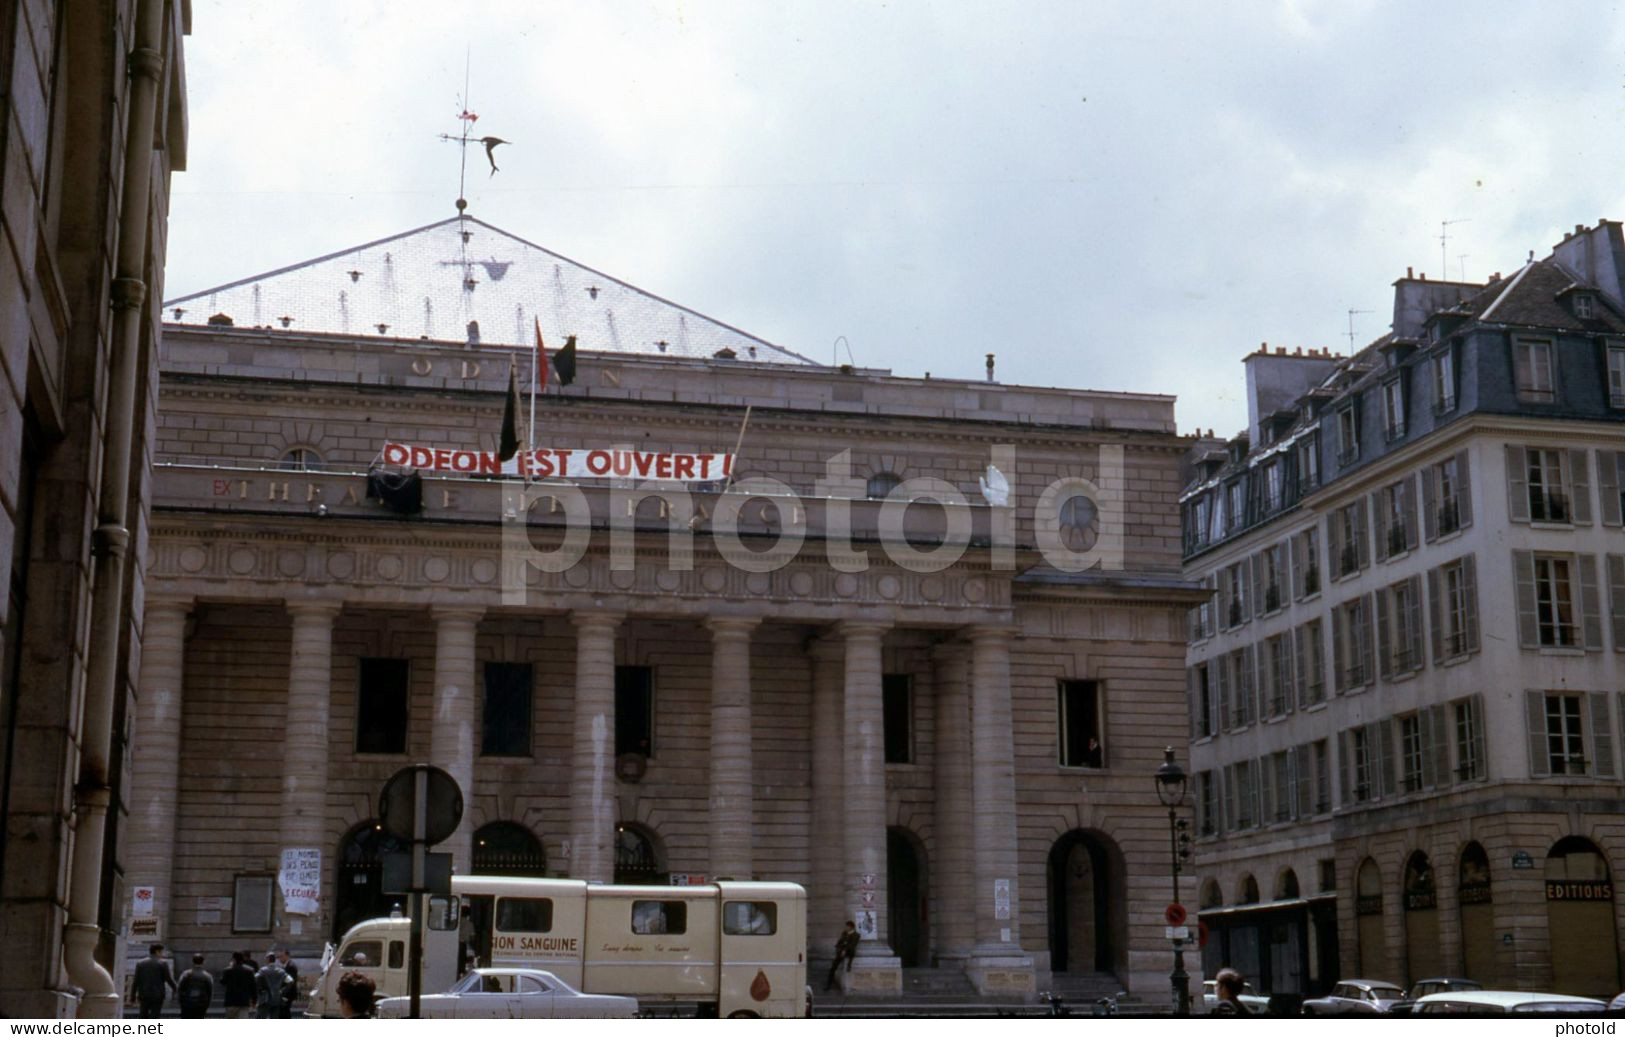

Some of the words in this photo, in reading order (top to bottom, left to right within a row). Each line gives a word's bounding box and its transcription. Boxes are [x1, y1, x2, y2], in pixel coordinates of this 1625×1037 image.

[383, 443, 501, 474] ODEON
[517, 449, 573, 476] EST
[586, 452, 714, 479] OUVERT
[212, 480, 232, 496] EX
[1547, 884, 1612, 898] EDITIONS
[521, 937, 577, 951] SANGUINE
